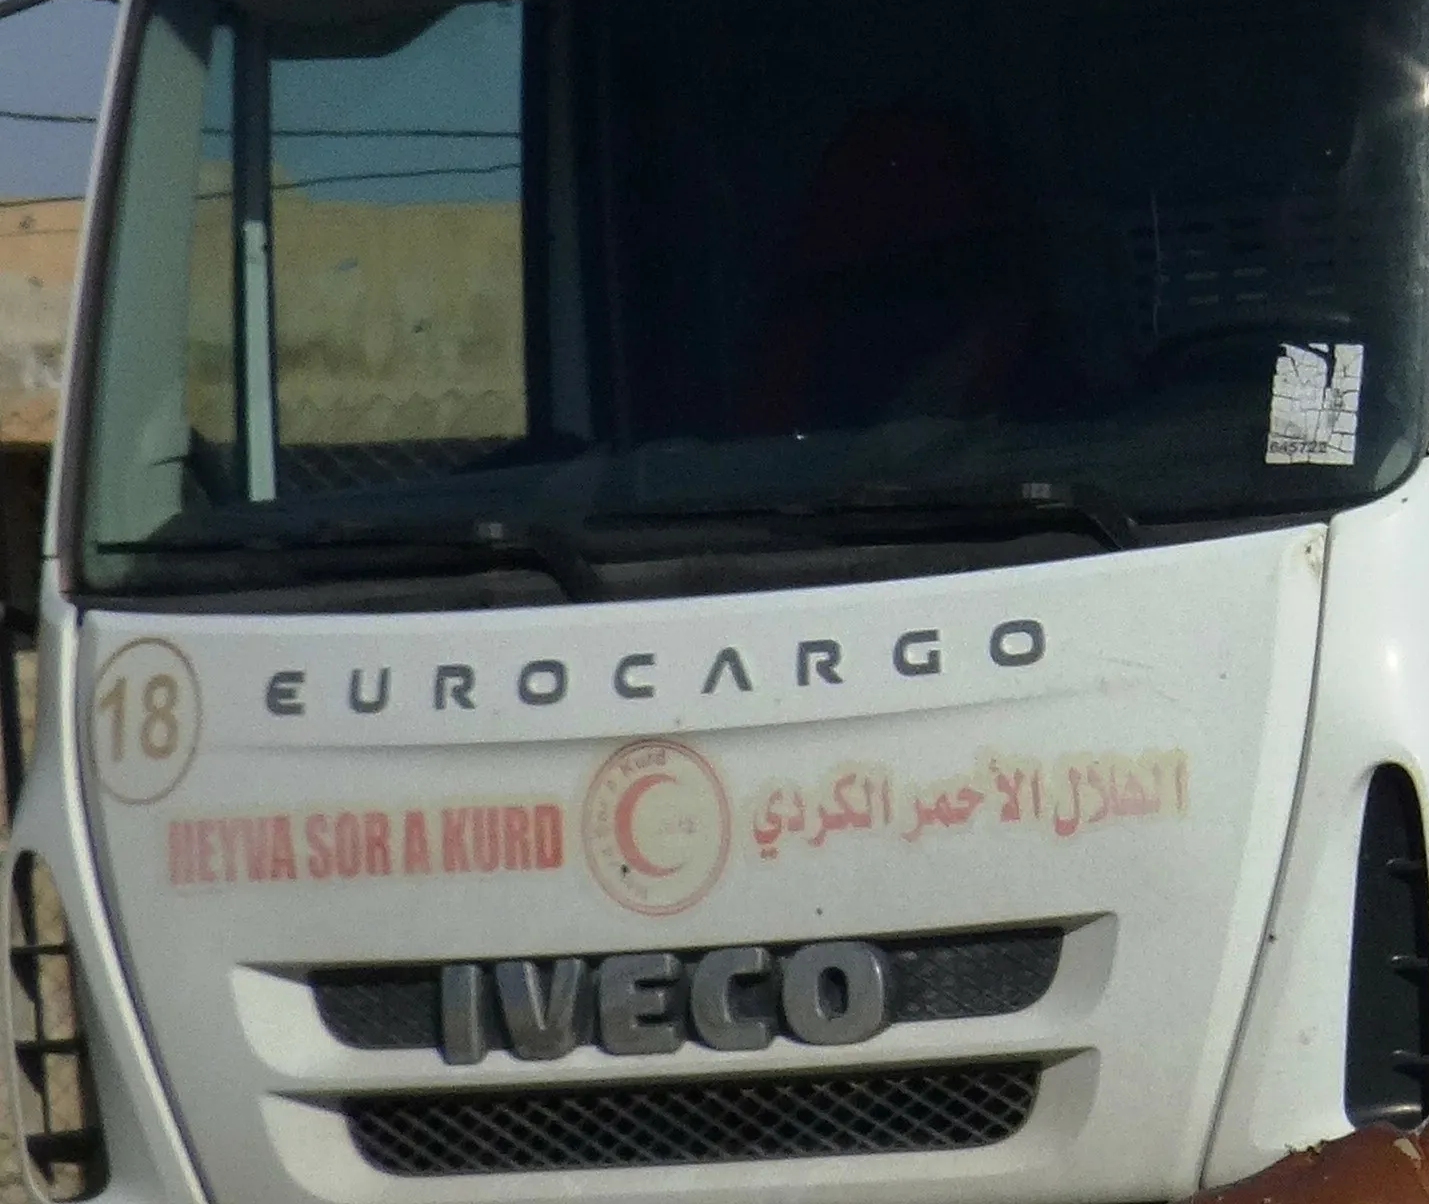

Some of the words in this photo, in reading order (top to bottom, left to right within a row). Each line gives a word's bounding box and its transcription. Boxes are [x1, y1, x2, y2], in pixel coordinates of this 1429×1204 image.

[265, 618, 1047, 717] EUROCARGO
[99, 672, 178, 763] 18
[167, 814, 297, 887] HEYVA
[305, 811, 392, 881] SOR
[403, 809, 434, 876] A
[441, 802, 565, 874] KURD
[439, 939, 888, 1067] IVECO
